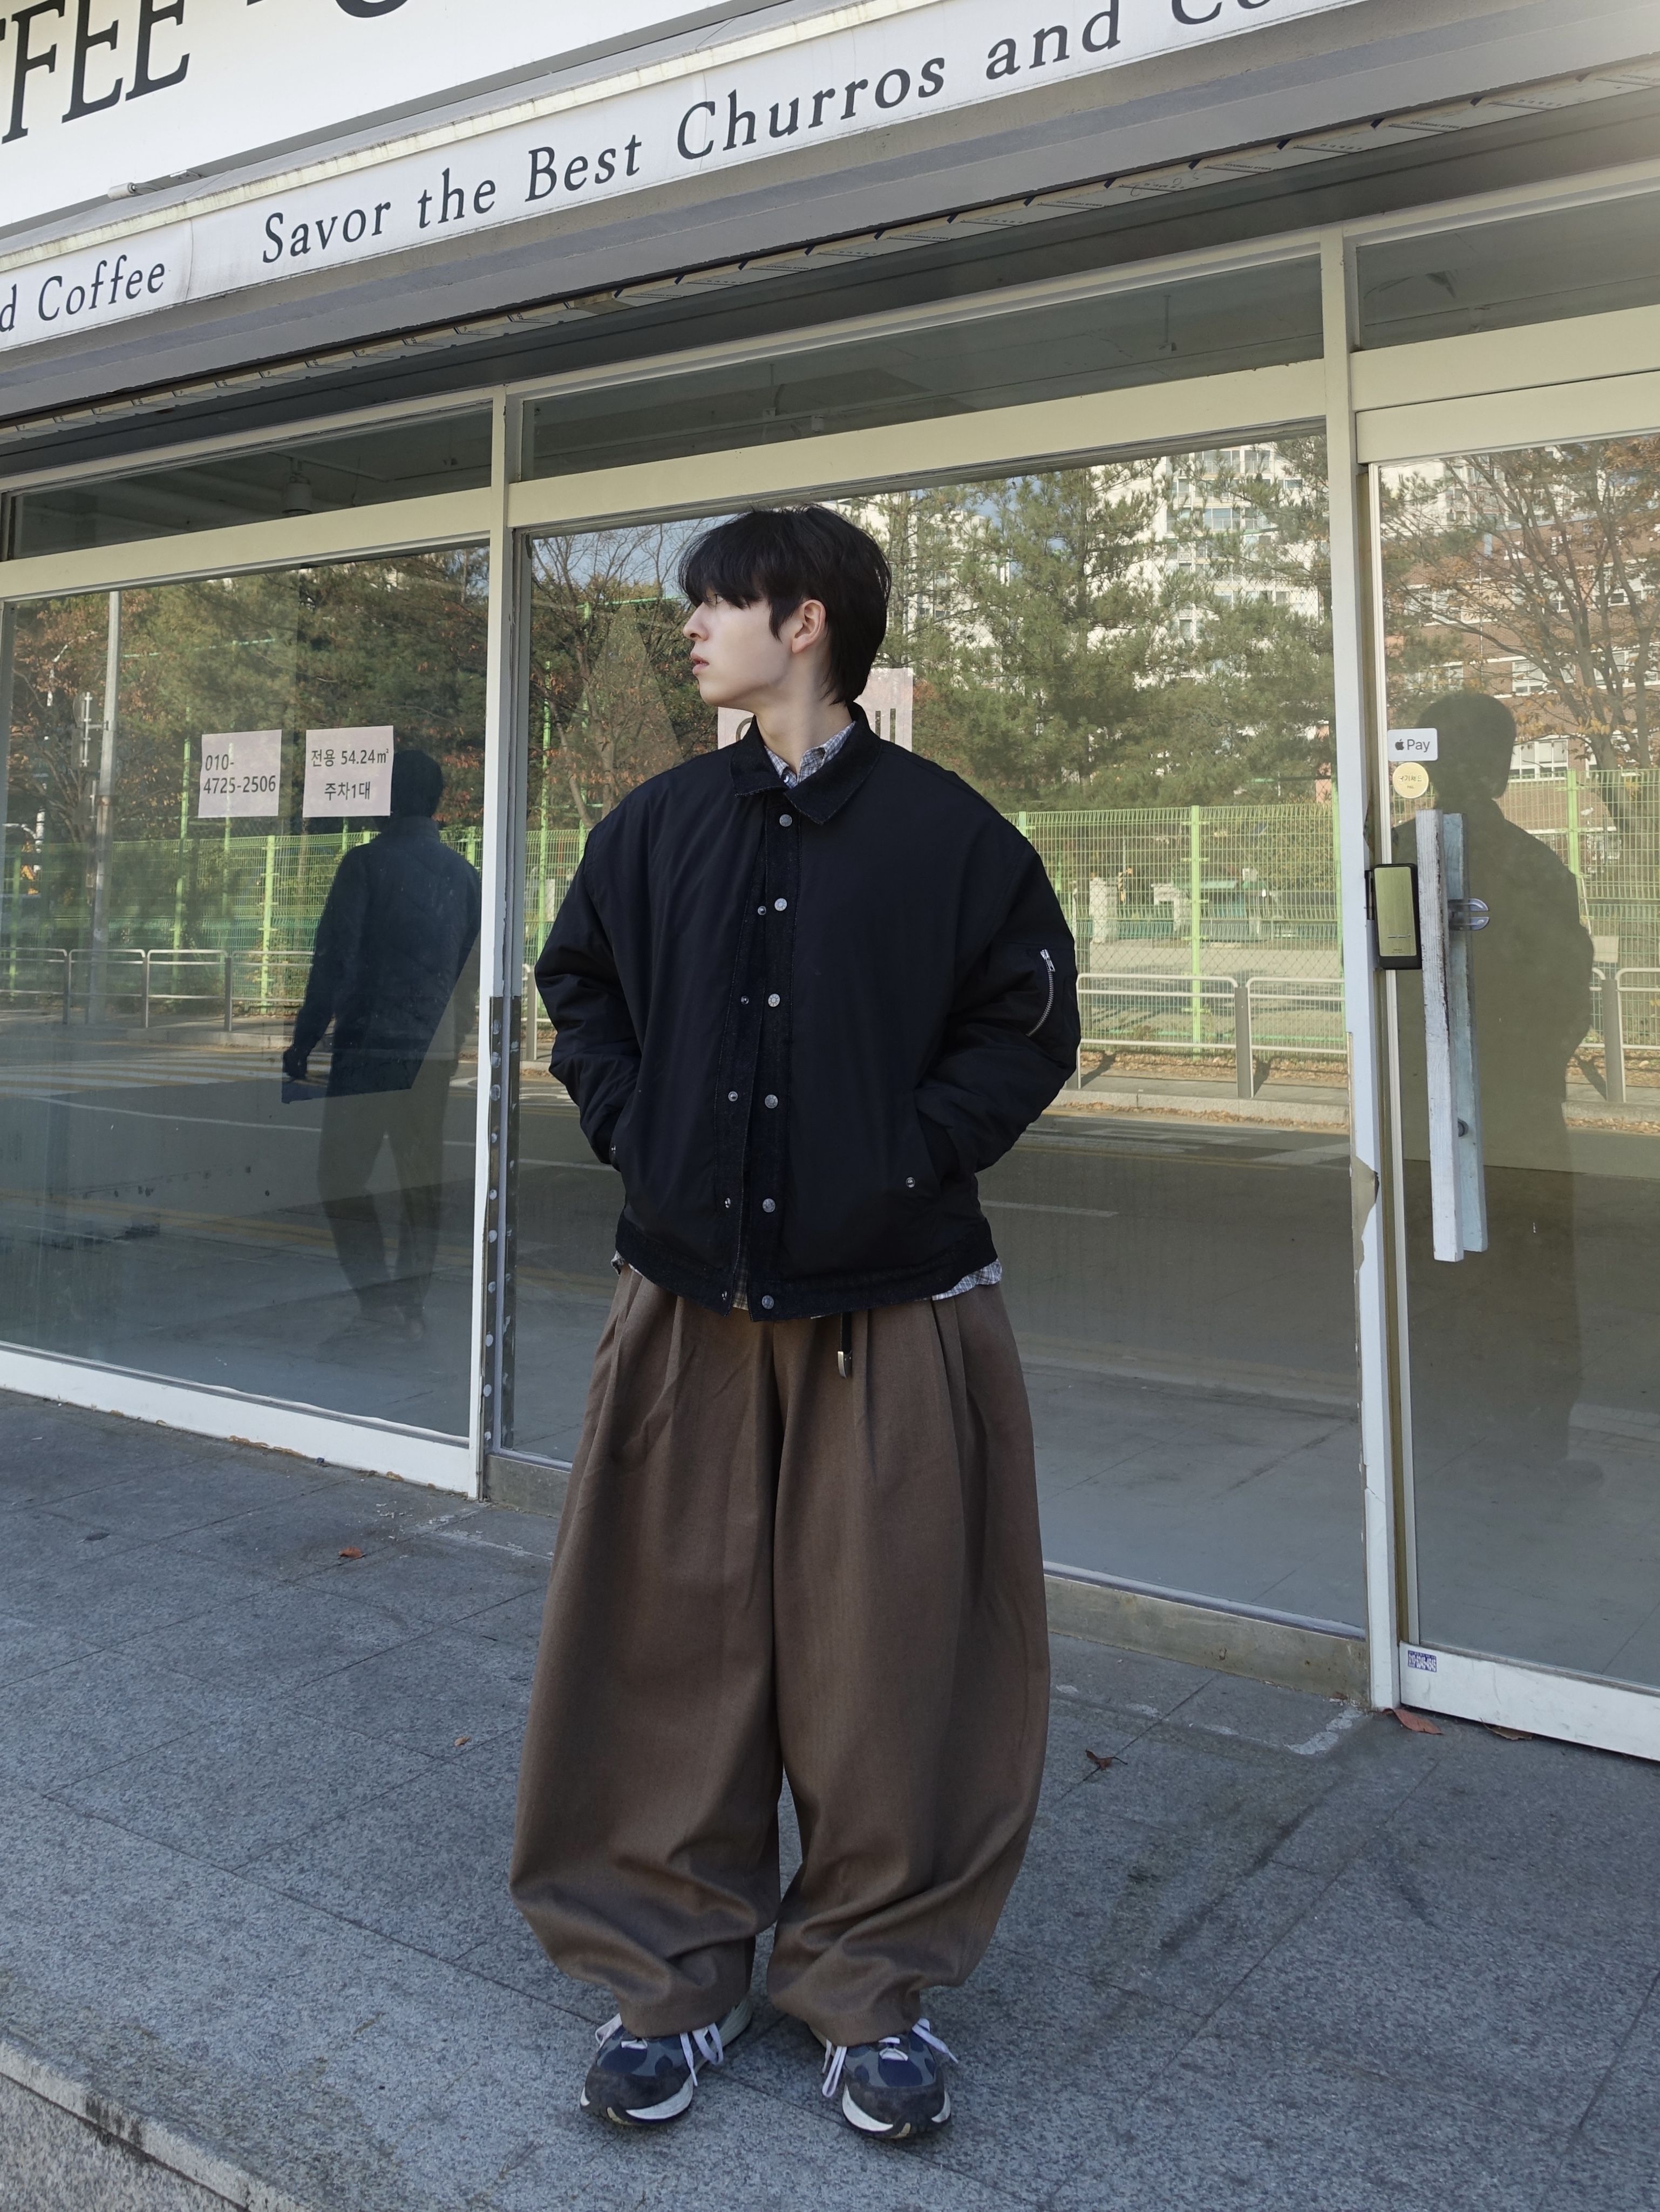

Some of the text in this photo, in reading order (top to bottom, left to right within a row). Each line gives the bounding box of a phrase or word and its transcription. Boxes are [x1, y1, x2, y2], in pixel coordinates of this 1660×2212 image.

[0, 0, 190, 144] FEE
[263, 0, 1120, 263] Savor the Best Churros and
[38, 254, 165, 321] Coffee
[1406, 739, 1431, 753] Pay
[205, 754, 234, 771] 010-
[311, 749, 336, 767] 전용
[203, 775, 276, 794] 4725-2506
[324, 781, 371, 801] 주차1대
